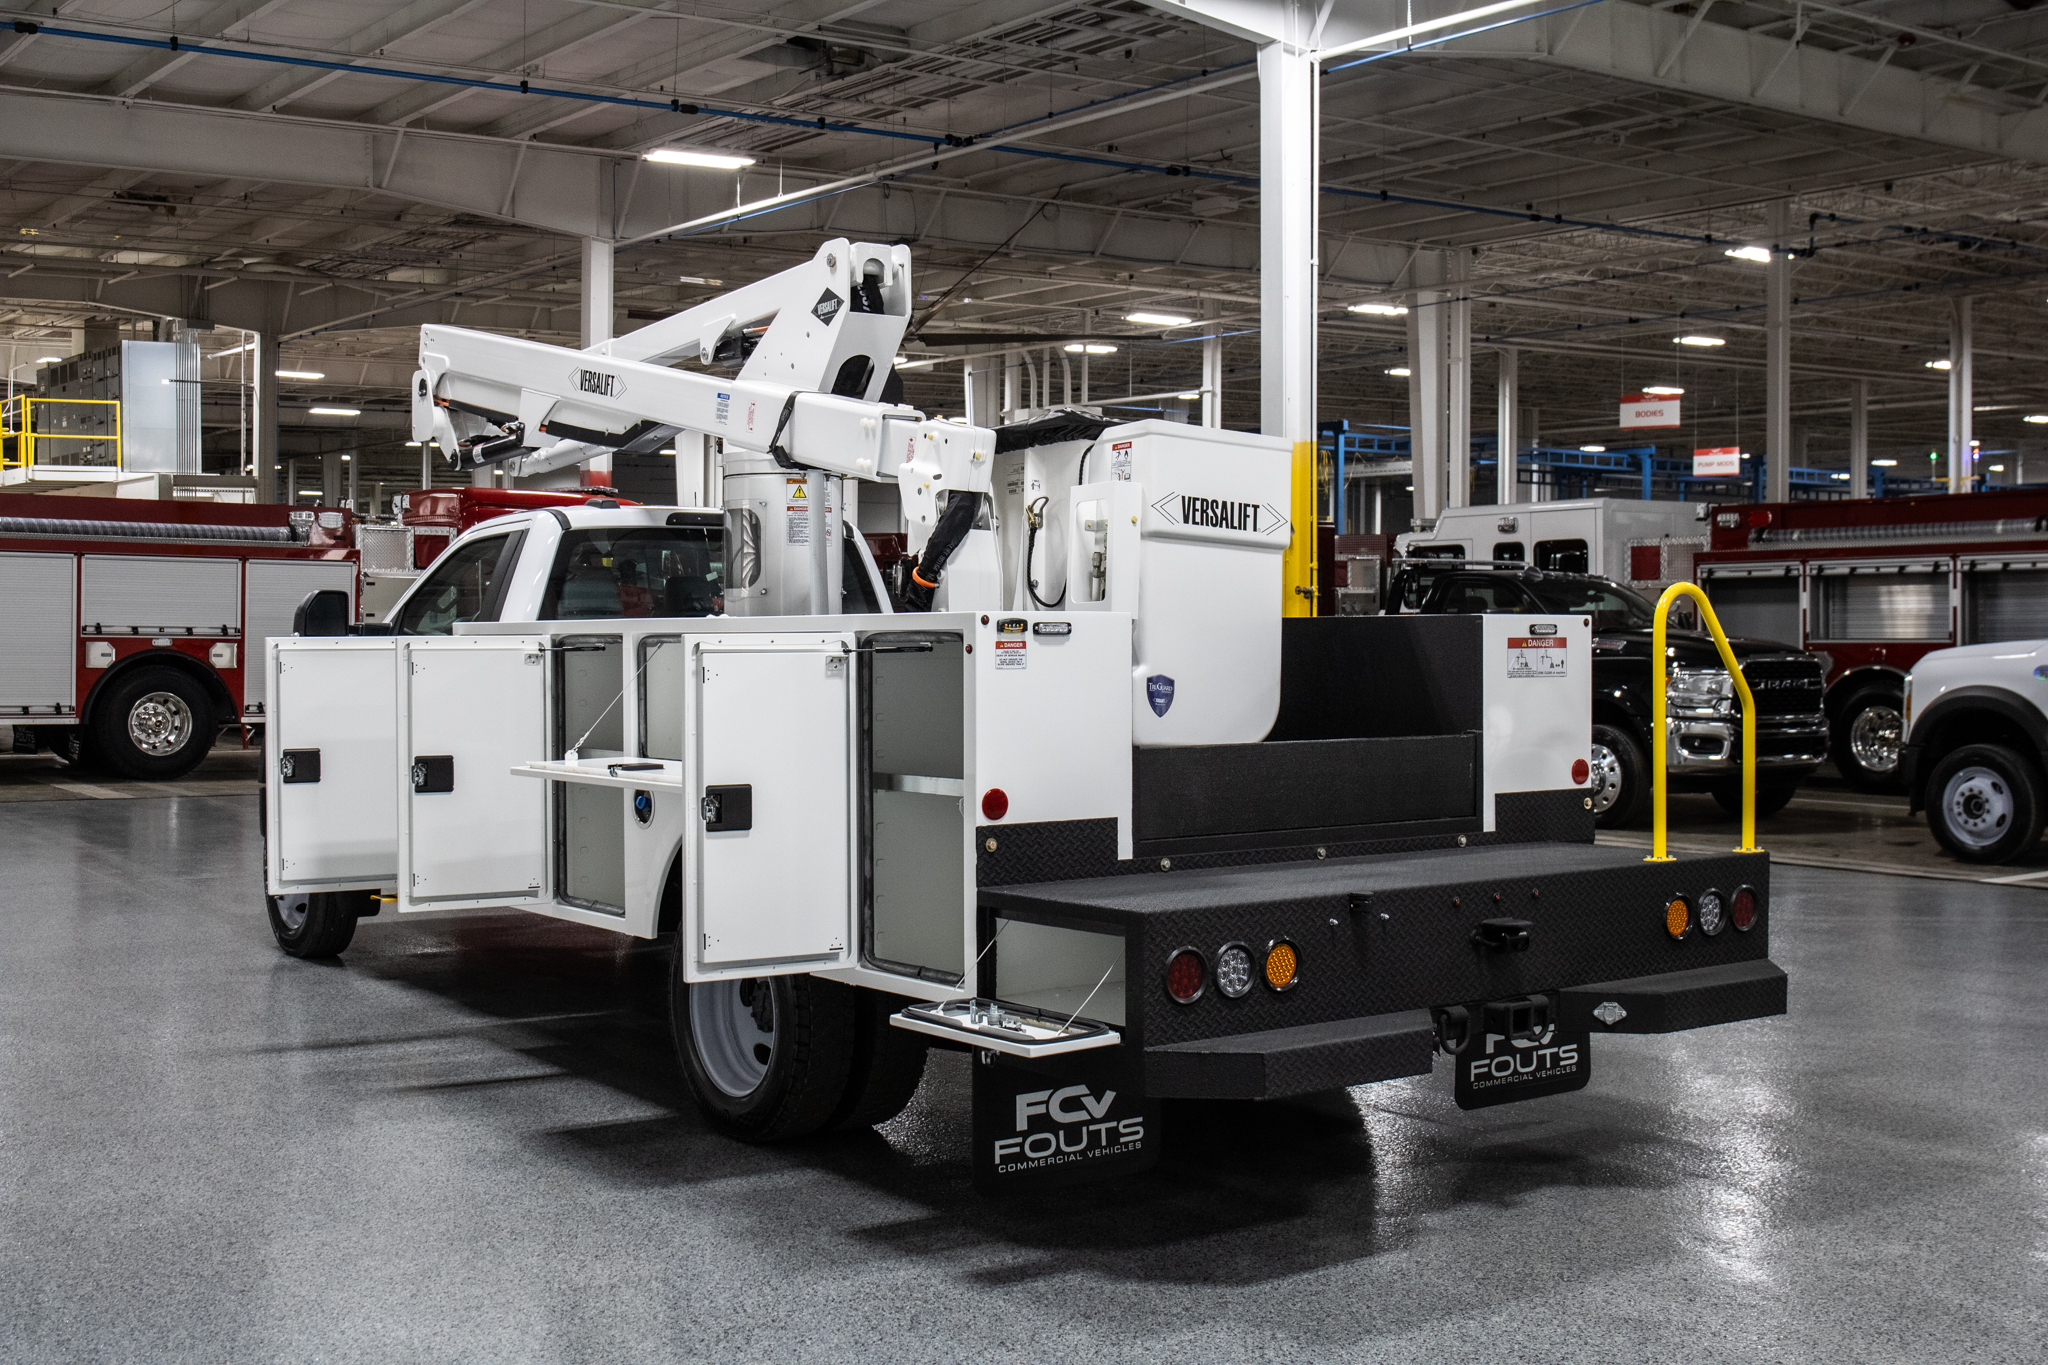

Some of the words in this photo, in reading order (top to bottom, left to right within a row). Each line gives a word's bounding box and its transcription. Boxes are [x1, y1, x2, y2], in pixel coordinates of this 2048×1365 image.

[817, 298, 838, 315] VERSALIFT
[580, 369, 615, 397] VERSALIFT
[1635, 409, 1664, 418] BODIES
[1181, 495, 1260, 532] VERSALIFT
[1528, 639, 1554, 647] DANGER
[1470, 1044, 1578, 1082] FOUTS
[1472, 1073, 1533, 1089] COMMERCIAL
[1536, 1064, 1577, 1078] VEHICLES
[994, 1116, 1144, 1164] FOUTS
[998, 1153, 1083, 1173] COMMERCIAL
[1087, 1141, 1142, 1158] VEHICLES
